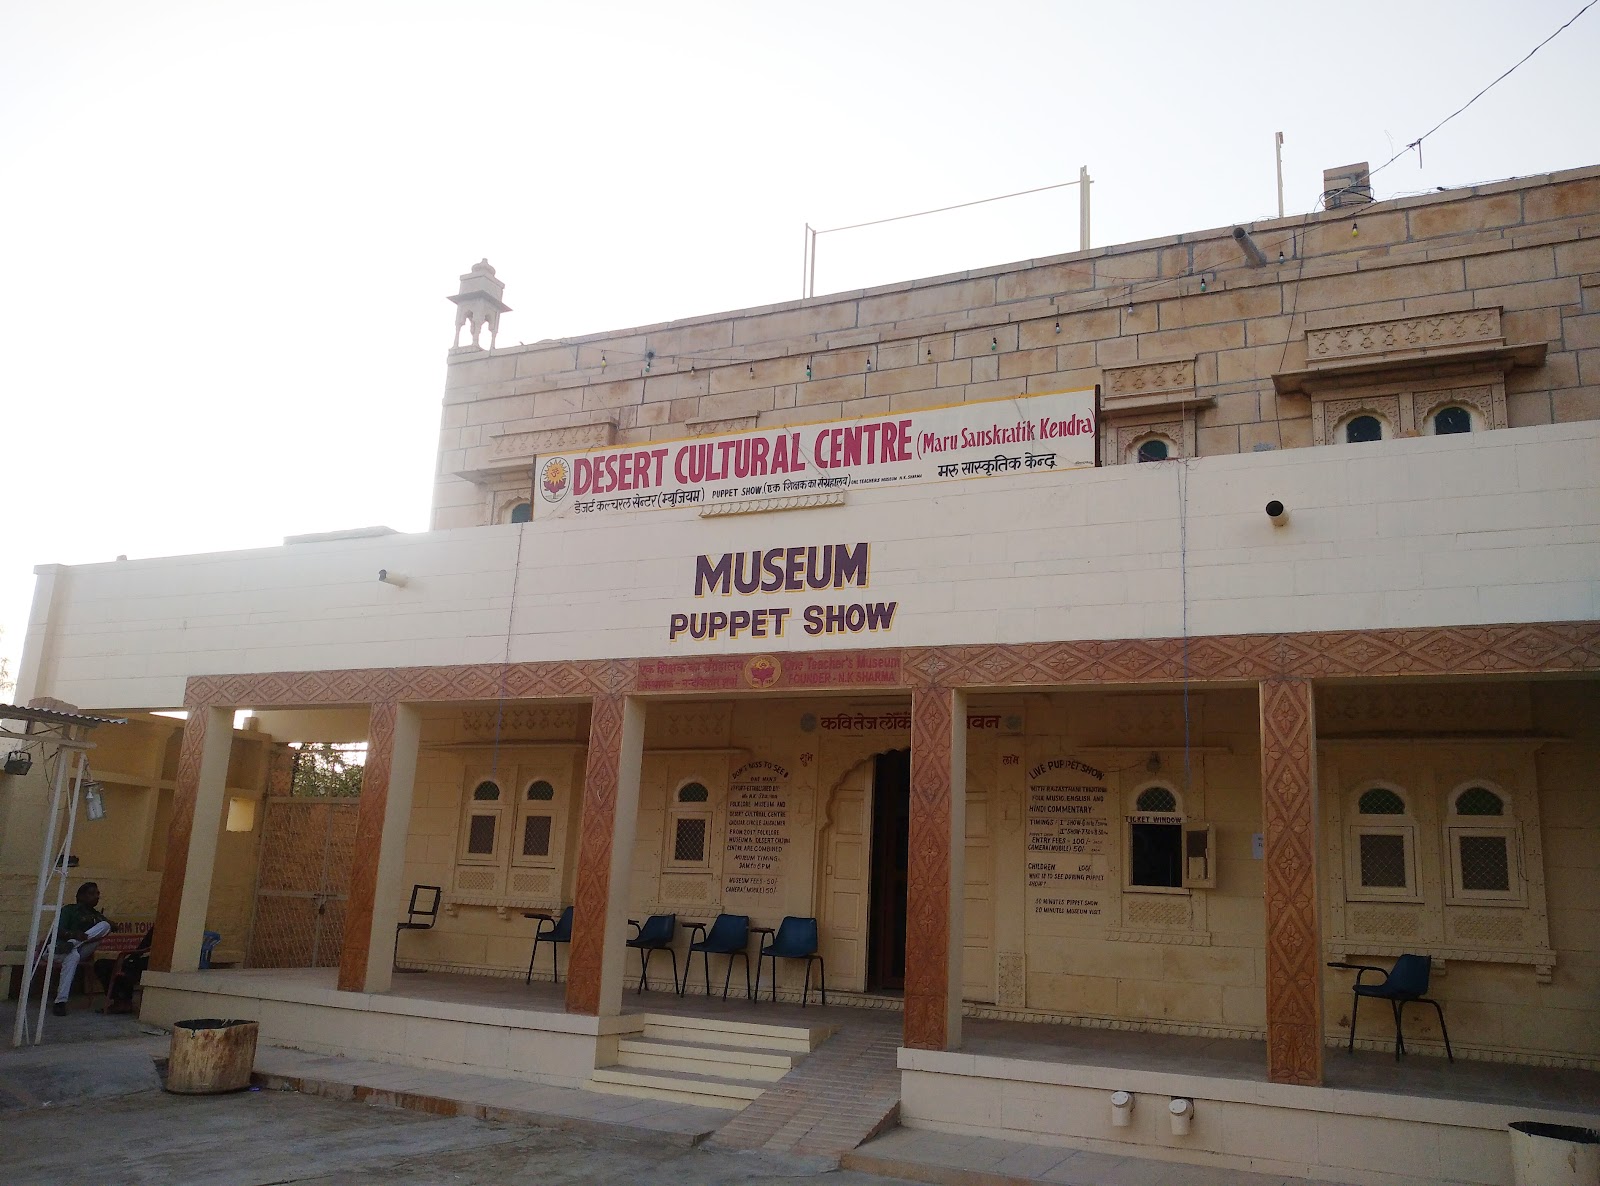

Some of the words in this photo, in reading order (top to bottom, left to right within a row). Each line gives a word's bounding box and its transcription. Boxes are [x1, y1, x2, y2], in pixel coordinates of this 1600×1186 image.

[572, 448, 669, 496] DESERT
[674, 432, 806, 485] CULTURAL
[813, 419, 913, 469] CENTRE
[916, 429, 958, 460] (Maru
[960, 420, 1036, 449] Sanskratik
[1039, 407, 1097, 441] Kendra)
[937, 463, 960, 478] मरु
[1024, 451, 1057, 470] केन्द्र
[807, 479, 817, 488] का
[711, 488, 739, 499] PUPPET
[694, 542, 871, 599] MUSEUM
[669, 607, 792, 643] PUPPET
[803, 601, 899, 636] SHOW
[783, 658, 804, 671] One
[807, 656, 854, 671] Teacher's
[856, 655, 900, 669] Museum
[788, 671, 831, 684] FOUNDER
[856, 670, 896, 683] SHARMA
[820, 713, 853, 730] कवि
[967, 714, 1002, 729] वन
[764, 761, 772, 769] TO
[1028, 764, 1047, 780] LIVE
[1047, 759, 1080, 771] PUPPET
[1080, 764, 1105, 781] SHOW
[1124, 815, 1149, 823] TICKET
[1031, 836, 1051, 844] ENTRY
[1028, 862, 1056, 871] CHILDREN
